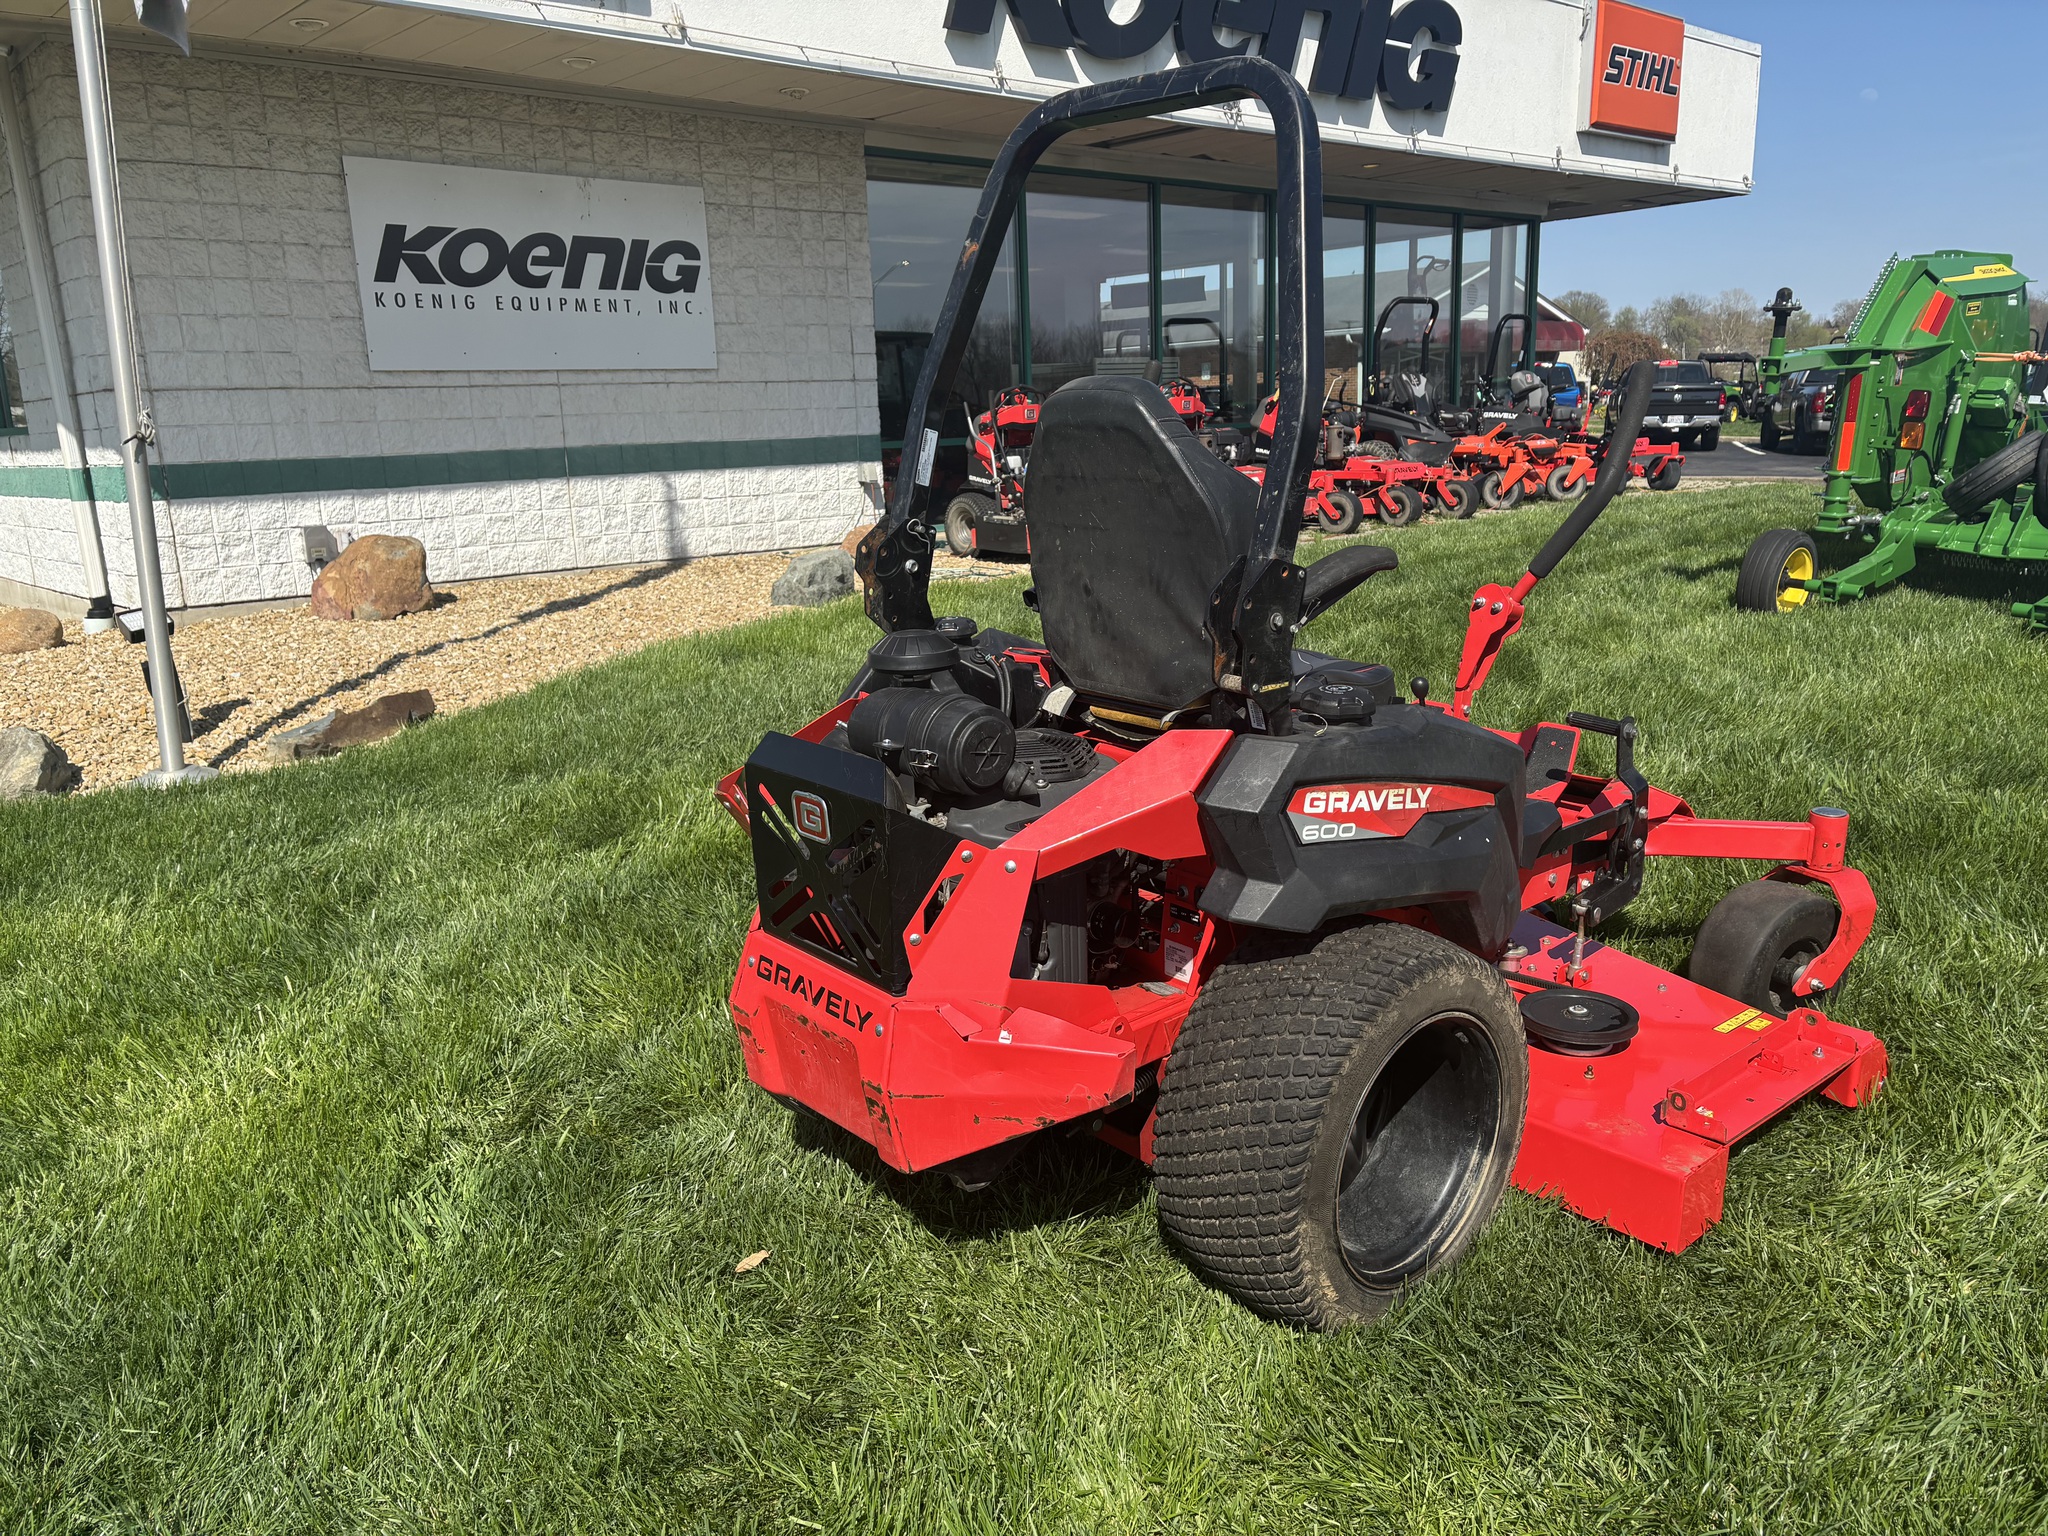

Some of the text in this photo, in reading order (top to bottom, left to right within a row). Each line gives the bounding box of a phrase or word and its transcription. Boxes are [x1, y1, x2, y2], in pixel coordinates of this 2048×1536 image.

[1603, 44, 1678, 96] STIHL
[374, 292, 702, 316] KOENIG EQUIPMENT, INC.
[1483, 411, 1518, 420] GRAVELY
[969, 475, 992, 485] GRAVELY
[1303, 787, 1433, 814] GRAVELY
[1302, 823, 1356, 840] 600
[757, 955, 873, 1032] GRAVELY
